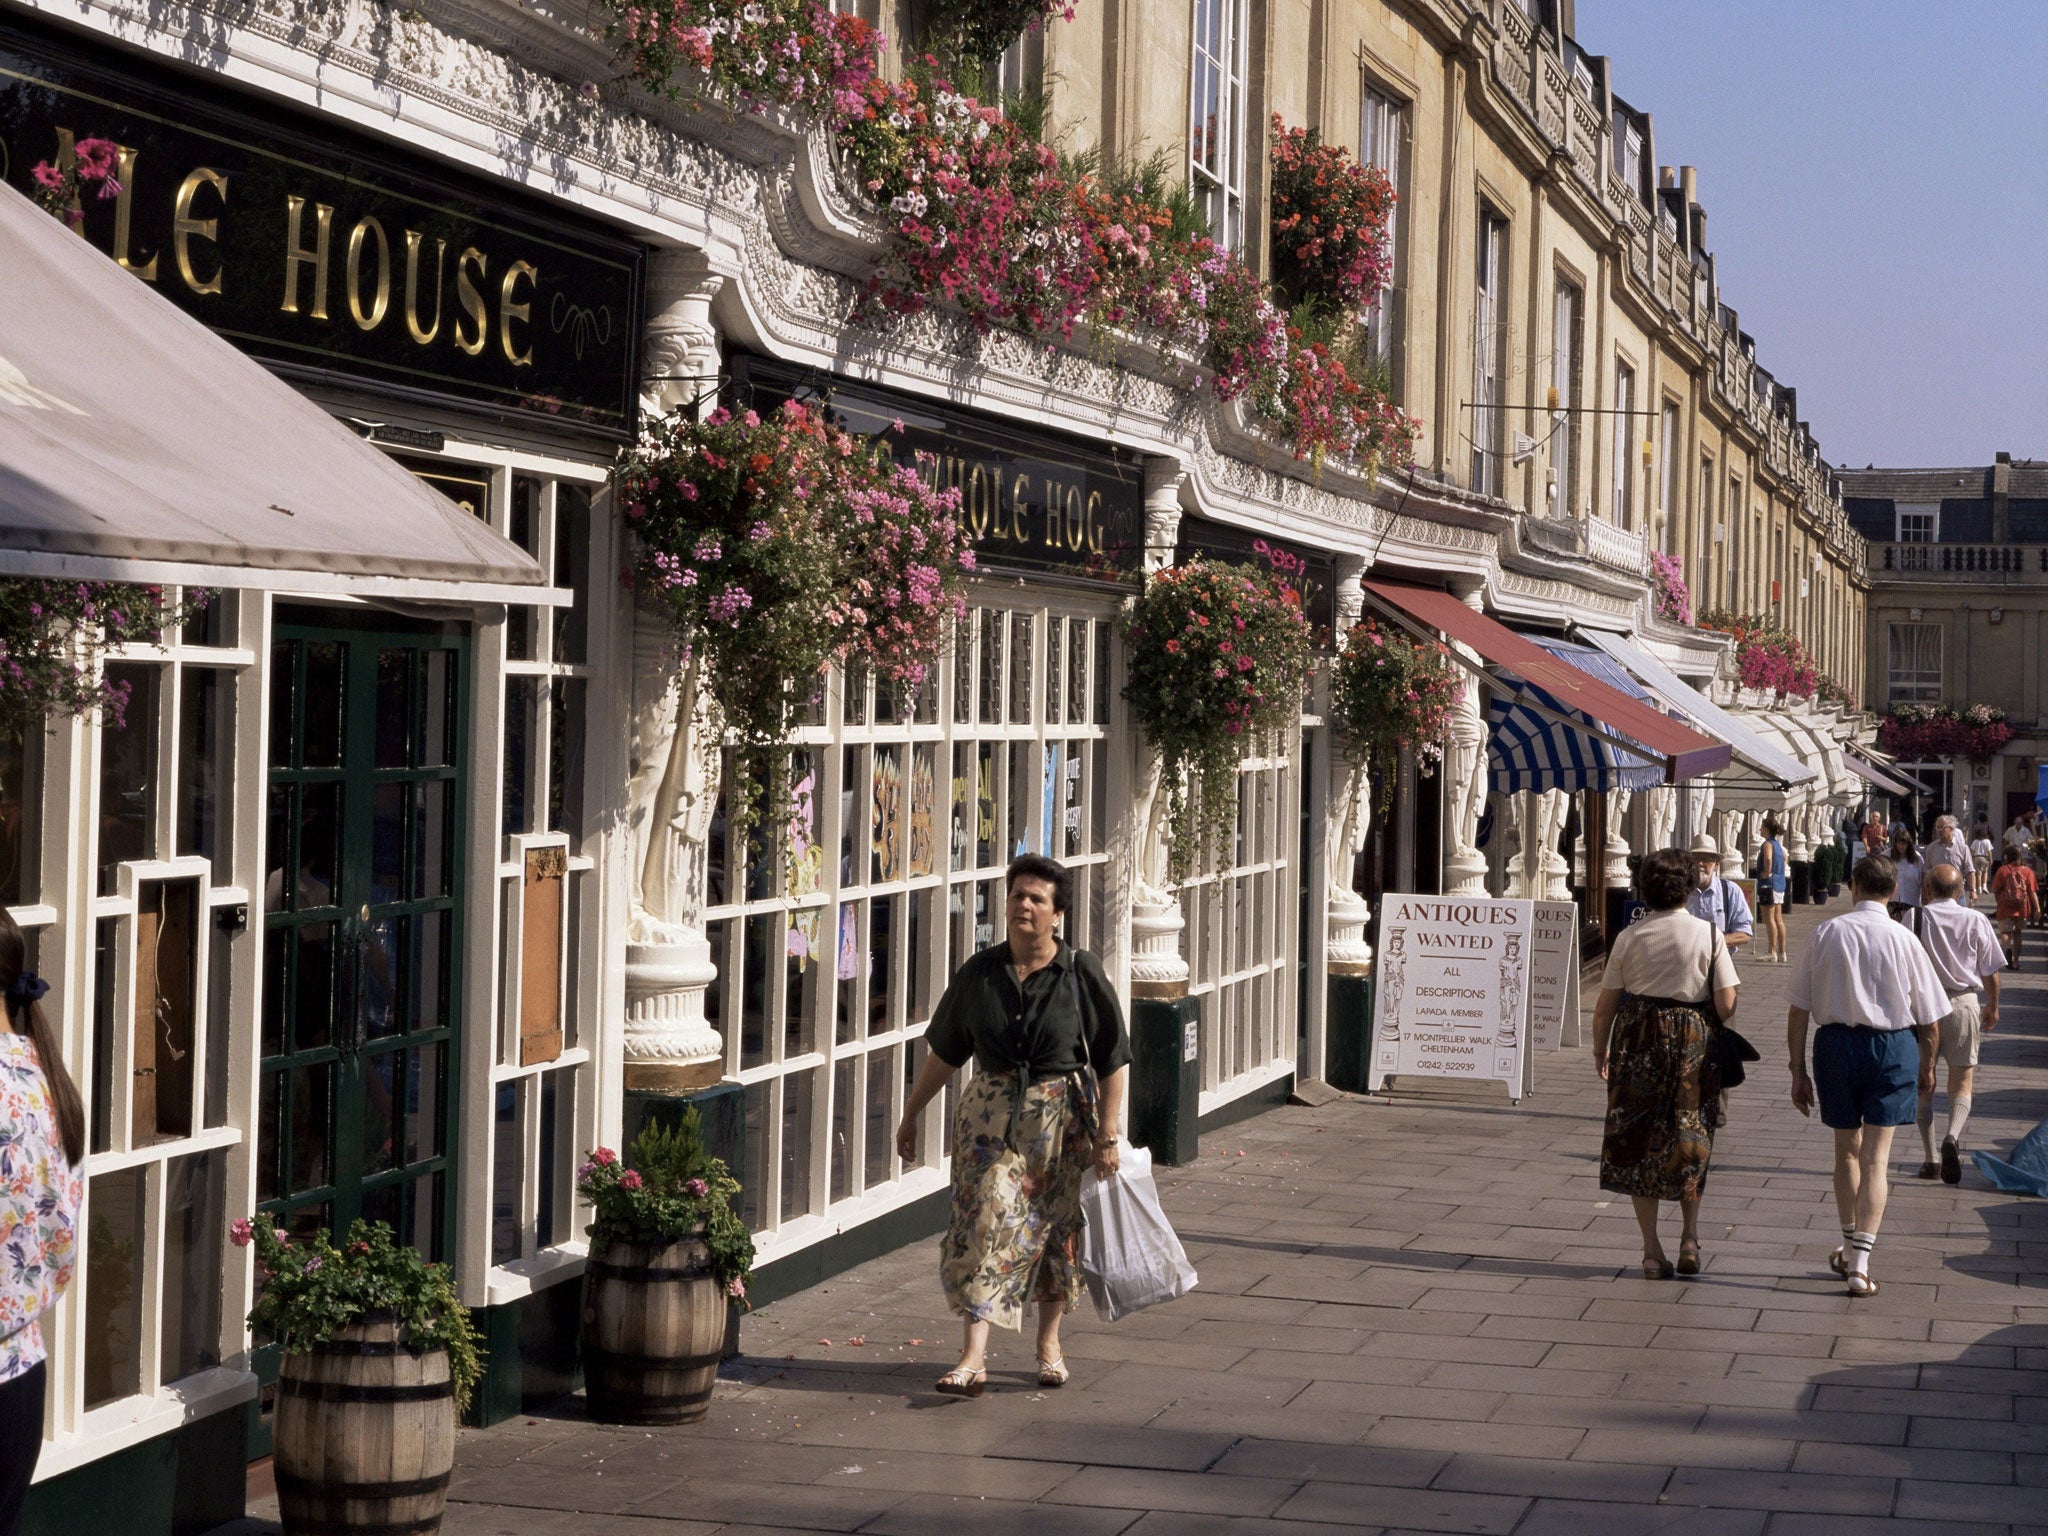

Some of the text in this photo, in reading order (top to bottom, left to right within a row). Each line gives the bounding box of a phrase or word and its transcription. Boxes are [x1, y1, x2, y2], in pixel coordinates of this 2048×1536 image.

[280, 194, 538, 367] HOUSE
[1046, 479, 1104, 555] HOG
[1395, 902, 1517, 926] ANTIQUES
[1534, 909, 1572, 923] QUES
[1417, 932, 1493, 950] WANTED
[1534, 928, 1562, 941] TED
[1443, 966, 1462, 977] ALL
[1533, 975, 1558, 986] TIONS
[1415, 986, 1486, 999] DESCRIPTIONS
[1415, 1007, 1484, 1018] LAPADA MEMBER
[1403, 1032, 1492, 1045] 17 MONTPELLIER WALK
[1420, 1044, 1474, 1055] CHELTENHAM
